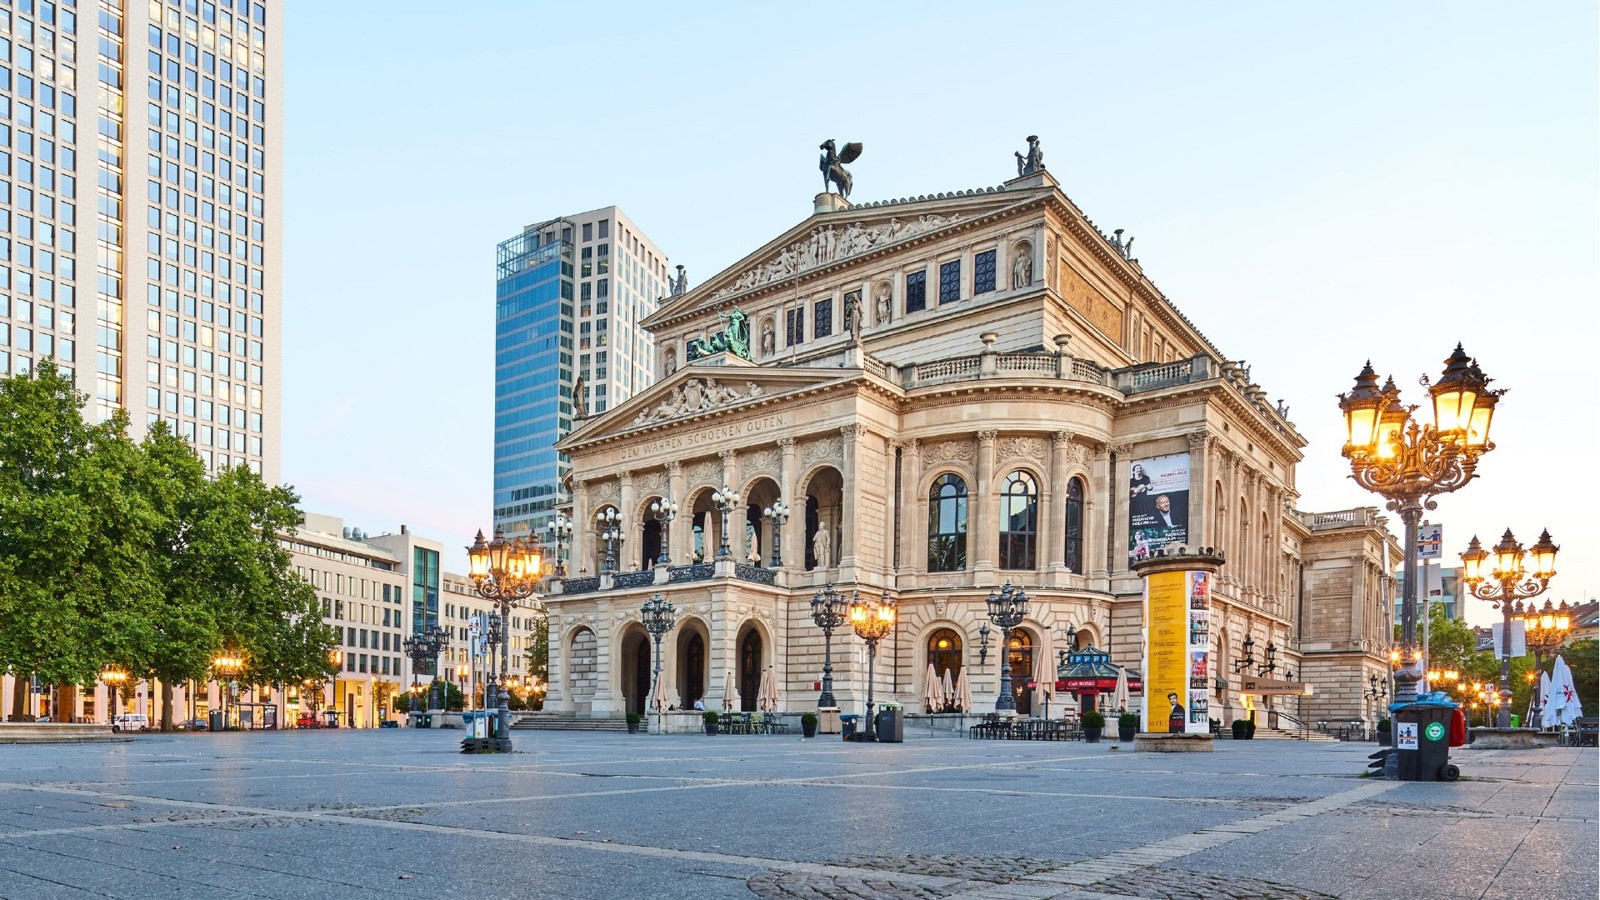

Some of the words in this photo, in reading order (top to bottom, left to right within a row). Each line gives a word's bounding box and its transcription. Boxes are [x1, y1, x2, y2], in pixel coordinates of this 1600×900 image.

[621, 449, 641, 460] DEM
[643, 438, 683, 455] WAHREN
[687, 425, 741, 444] SCHOENEN
[746, 415, 787, 432] GUTEN.
